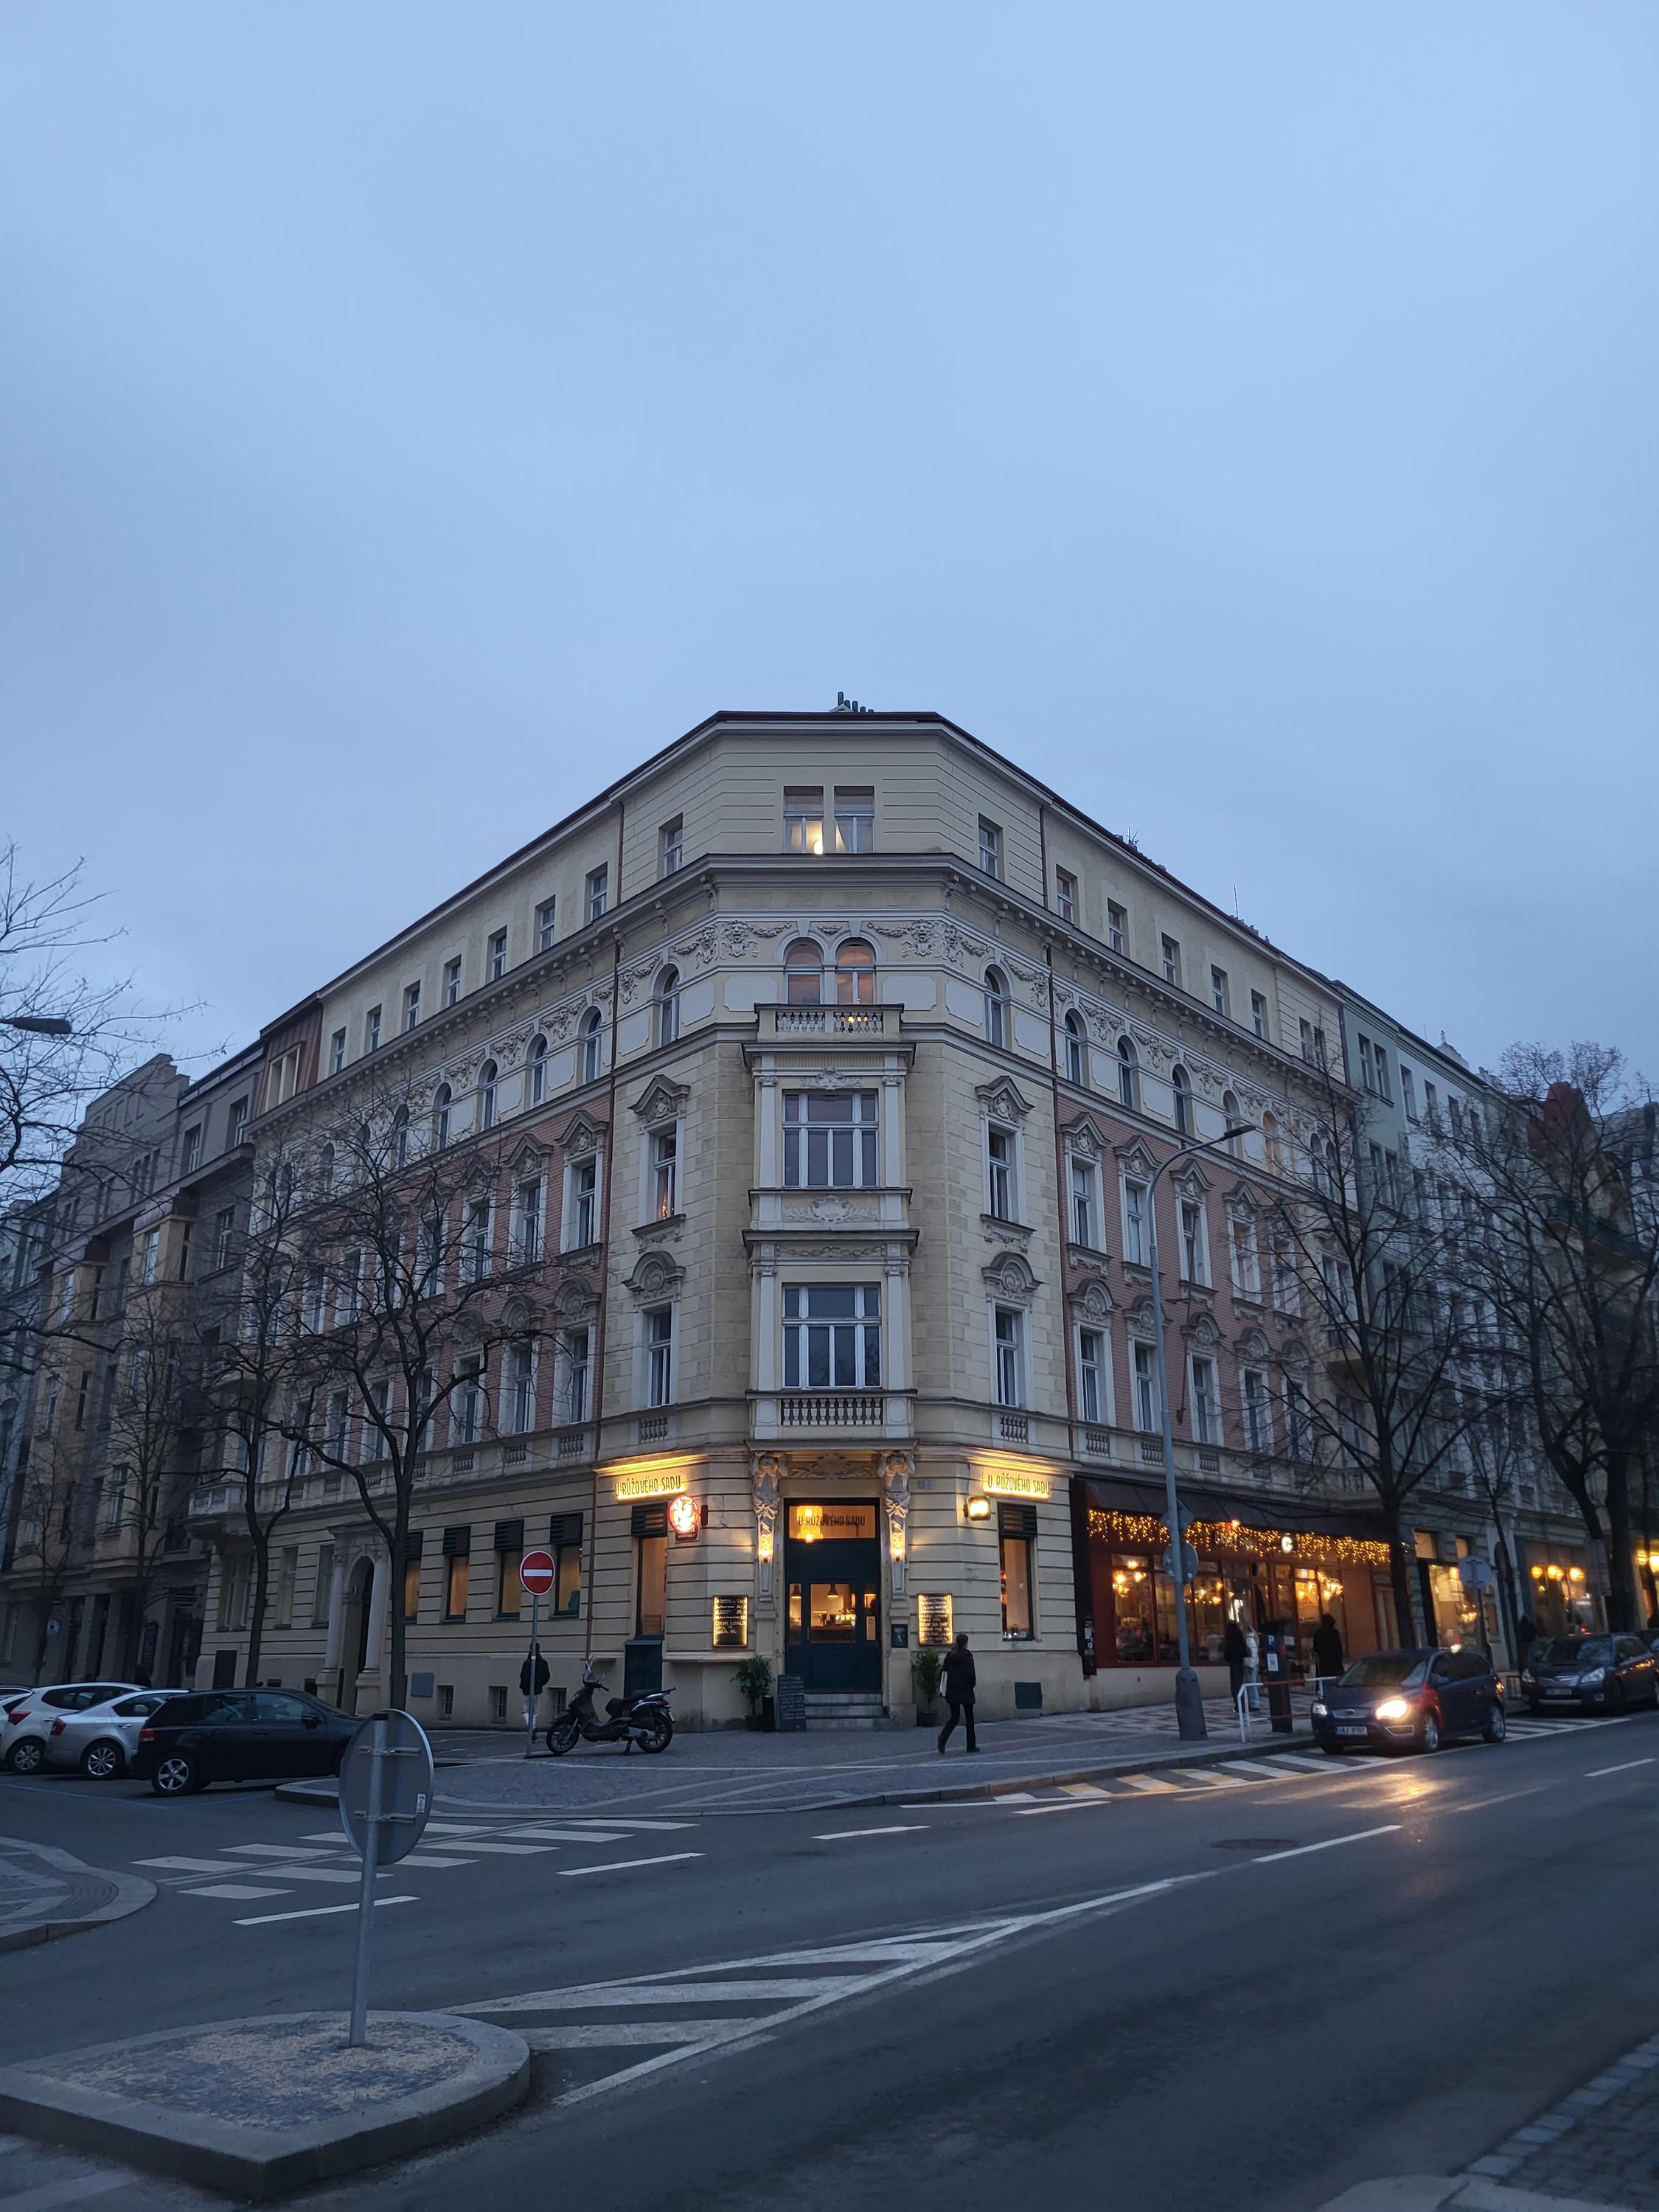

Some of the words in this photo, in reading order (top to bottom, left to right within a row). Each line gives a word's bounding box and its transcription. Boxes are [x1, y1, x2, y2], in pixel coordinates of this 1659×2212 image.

[615, 1482, 619, 1497] U
[622, 1475, 658, 1495] RŮŽOVÉHO
[661, 1475, 681, 1491] SADU
[987, 1474, 992, 1488] U
[996, 1472, 1031, 1492] RŮŽOVÉHO
[1033, 1480, 1050, 1495] SADU
[798, 1515, 804, 1526] U
[846, 1515, 866, 1526] SADU
[1268, 1635, 1275, 1646] P
